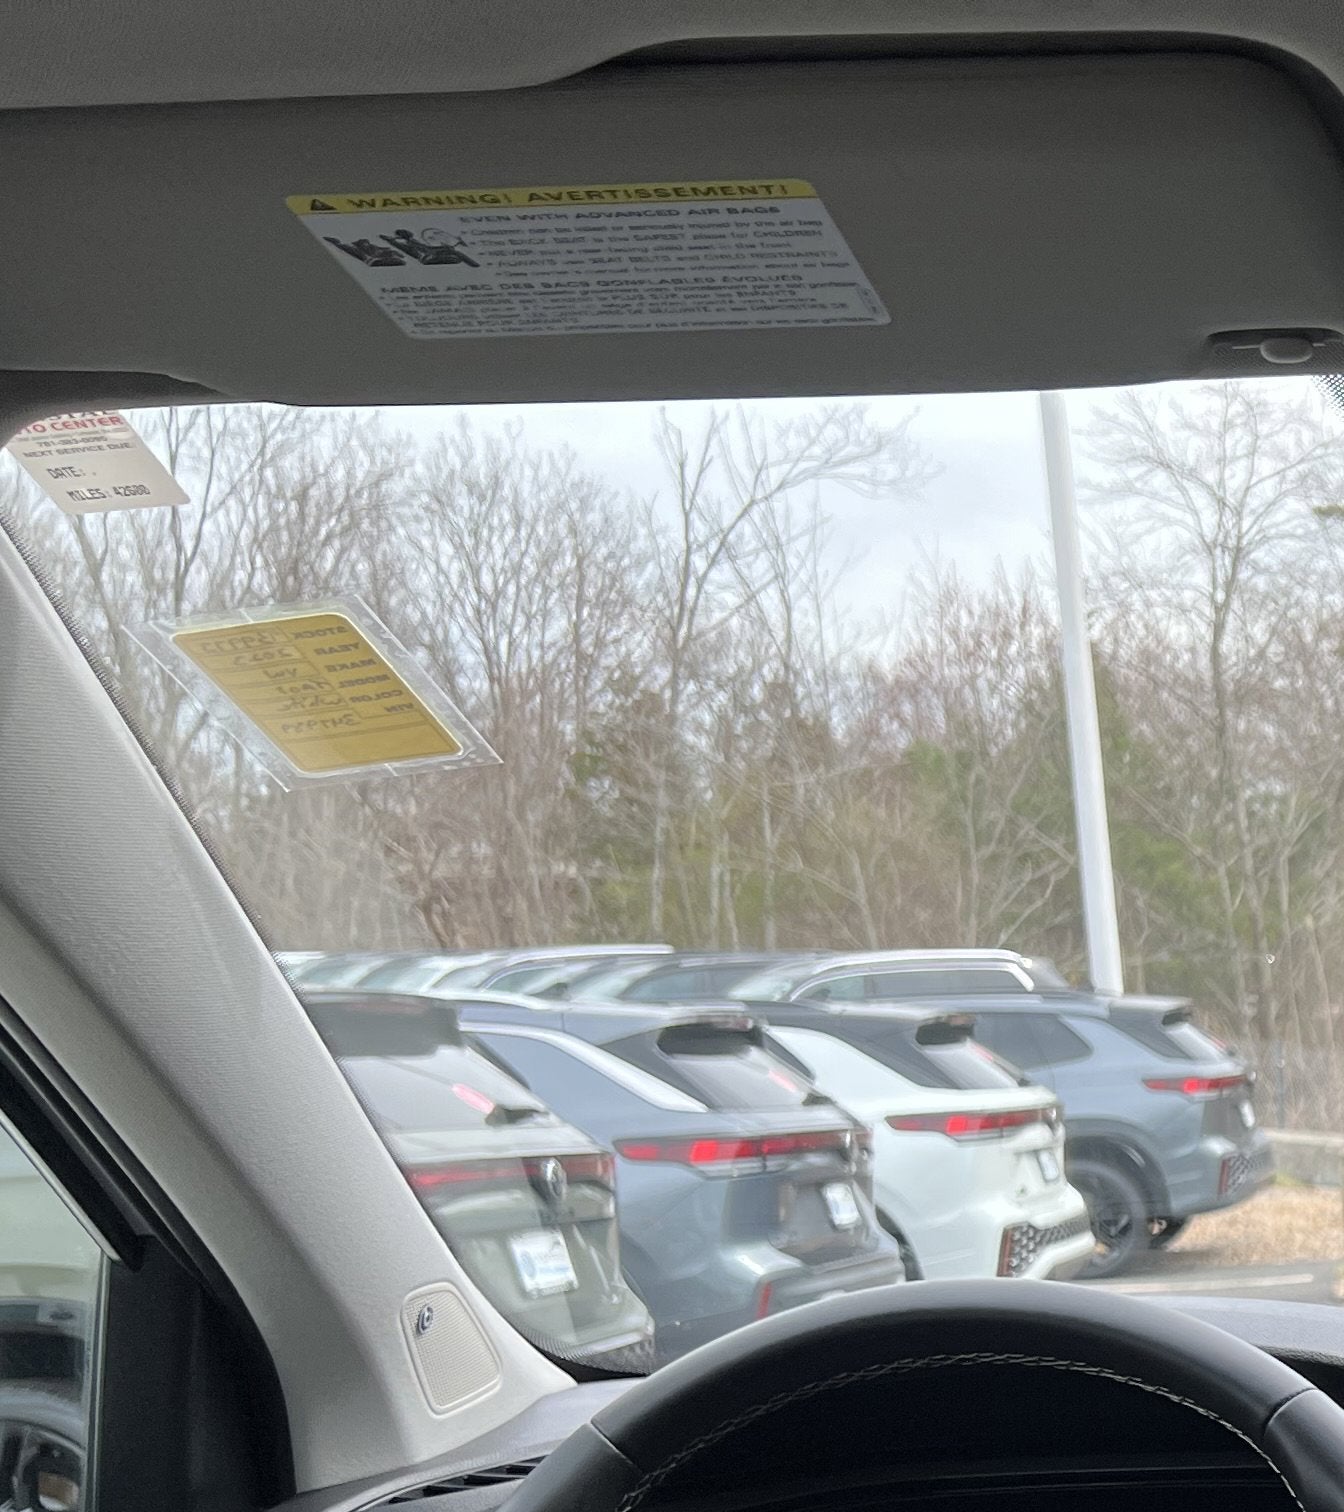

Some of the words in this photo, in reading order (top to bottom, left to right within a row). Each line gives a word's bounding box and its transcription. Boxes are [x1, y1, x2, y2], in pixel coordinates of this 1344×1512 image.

[345, 193, 514, 208] WARNING!
[522, 183, 789, 203] AVERTISSEMENT!
[457, 215, 512, 223] EVEN
[572, 209, 681, 219] ADVANCED
[52, 416, 124, 432] CENTER
[22, 449, 54, 459] NEXT
[55, 445, 105, 455] SERVICE
[107, 442, 133, 451] DUE
[46, 466, 86, 480] DATE:
[66, 487, 112, 502] MILES:
